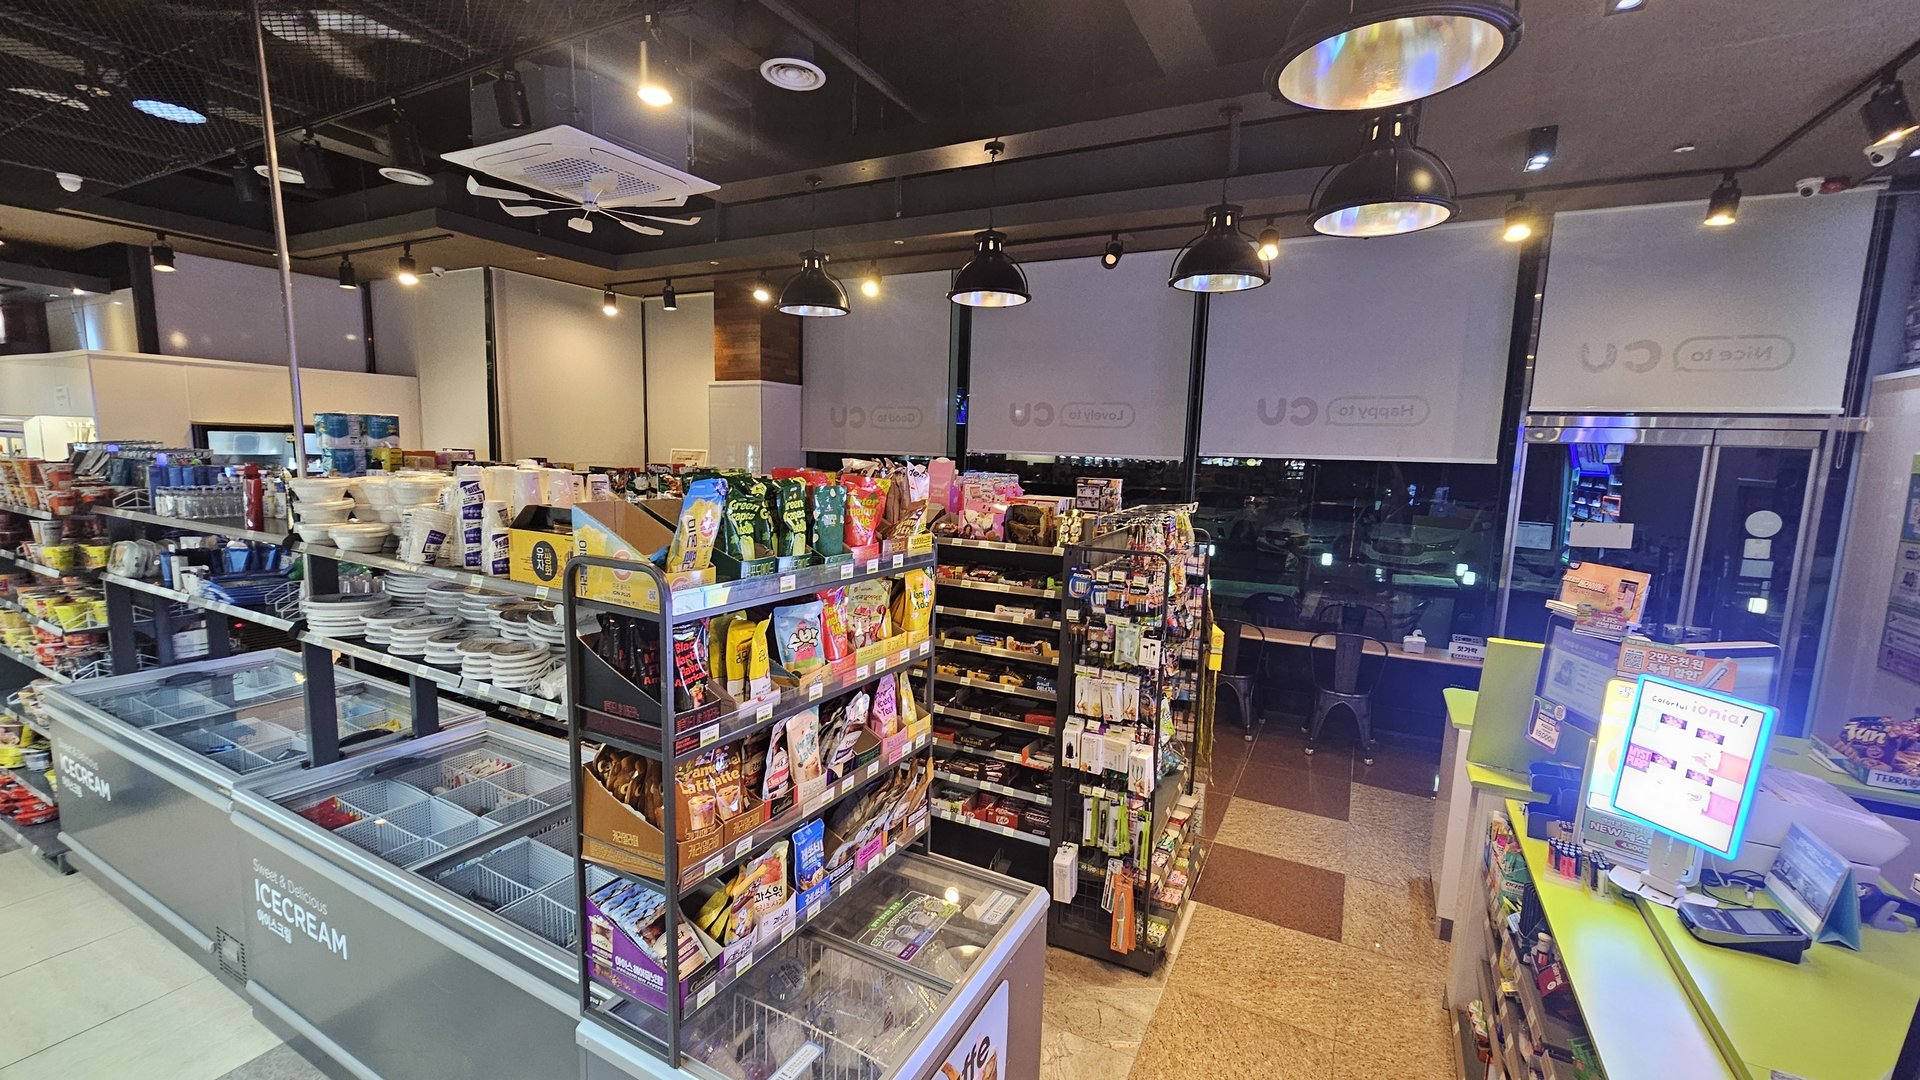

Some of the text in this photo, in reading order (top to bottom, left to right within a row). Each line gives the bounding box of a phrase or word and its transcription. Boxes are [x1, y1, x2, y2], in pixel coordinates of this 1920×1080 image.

[728, 499, 761, 512] Green
[785, 499, 804, 511] reen
[1649, 651, 1669, 664] 2만
[1690, 659, 1705, 671] 원
[1652, 695, 1688, 711] Colorful
[59, 752, 111, 802] ICECREAM
[1590, 820, 1622, 837] NEW
[253, 858, 328, 916] Sweet & Delicious
[754, 883, 784, 904] 과수원
[255, 878, 348, 961] ICECREAM
[256, 908, 293, 945] 아이스크림
